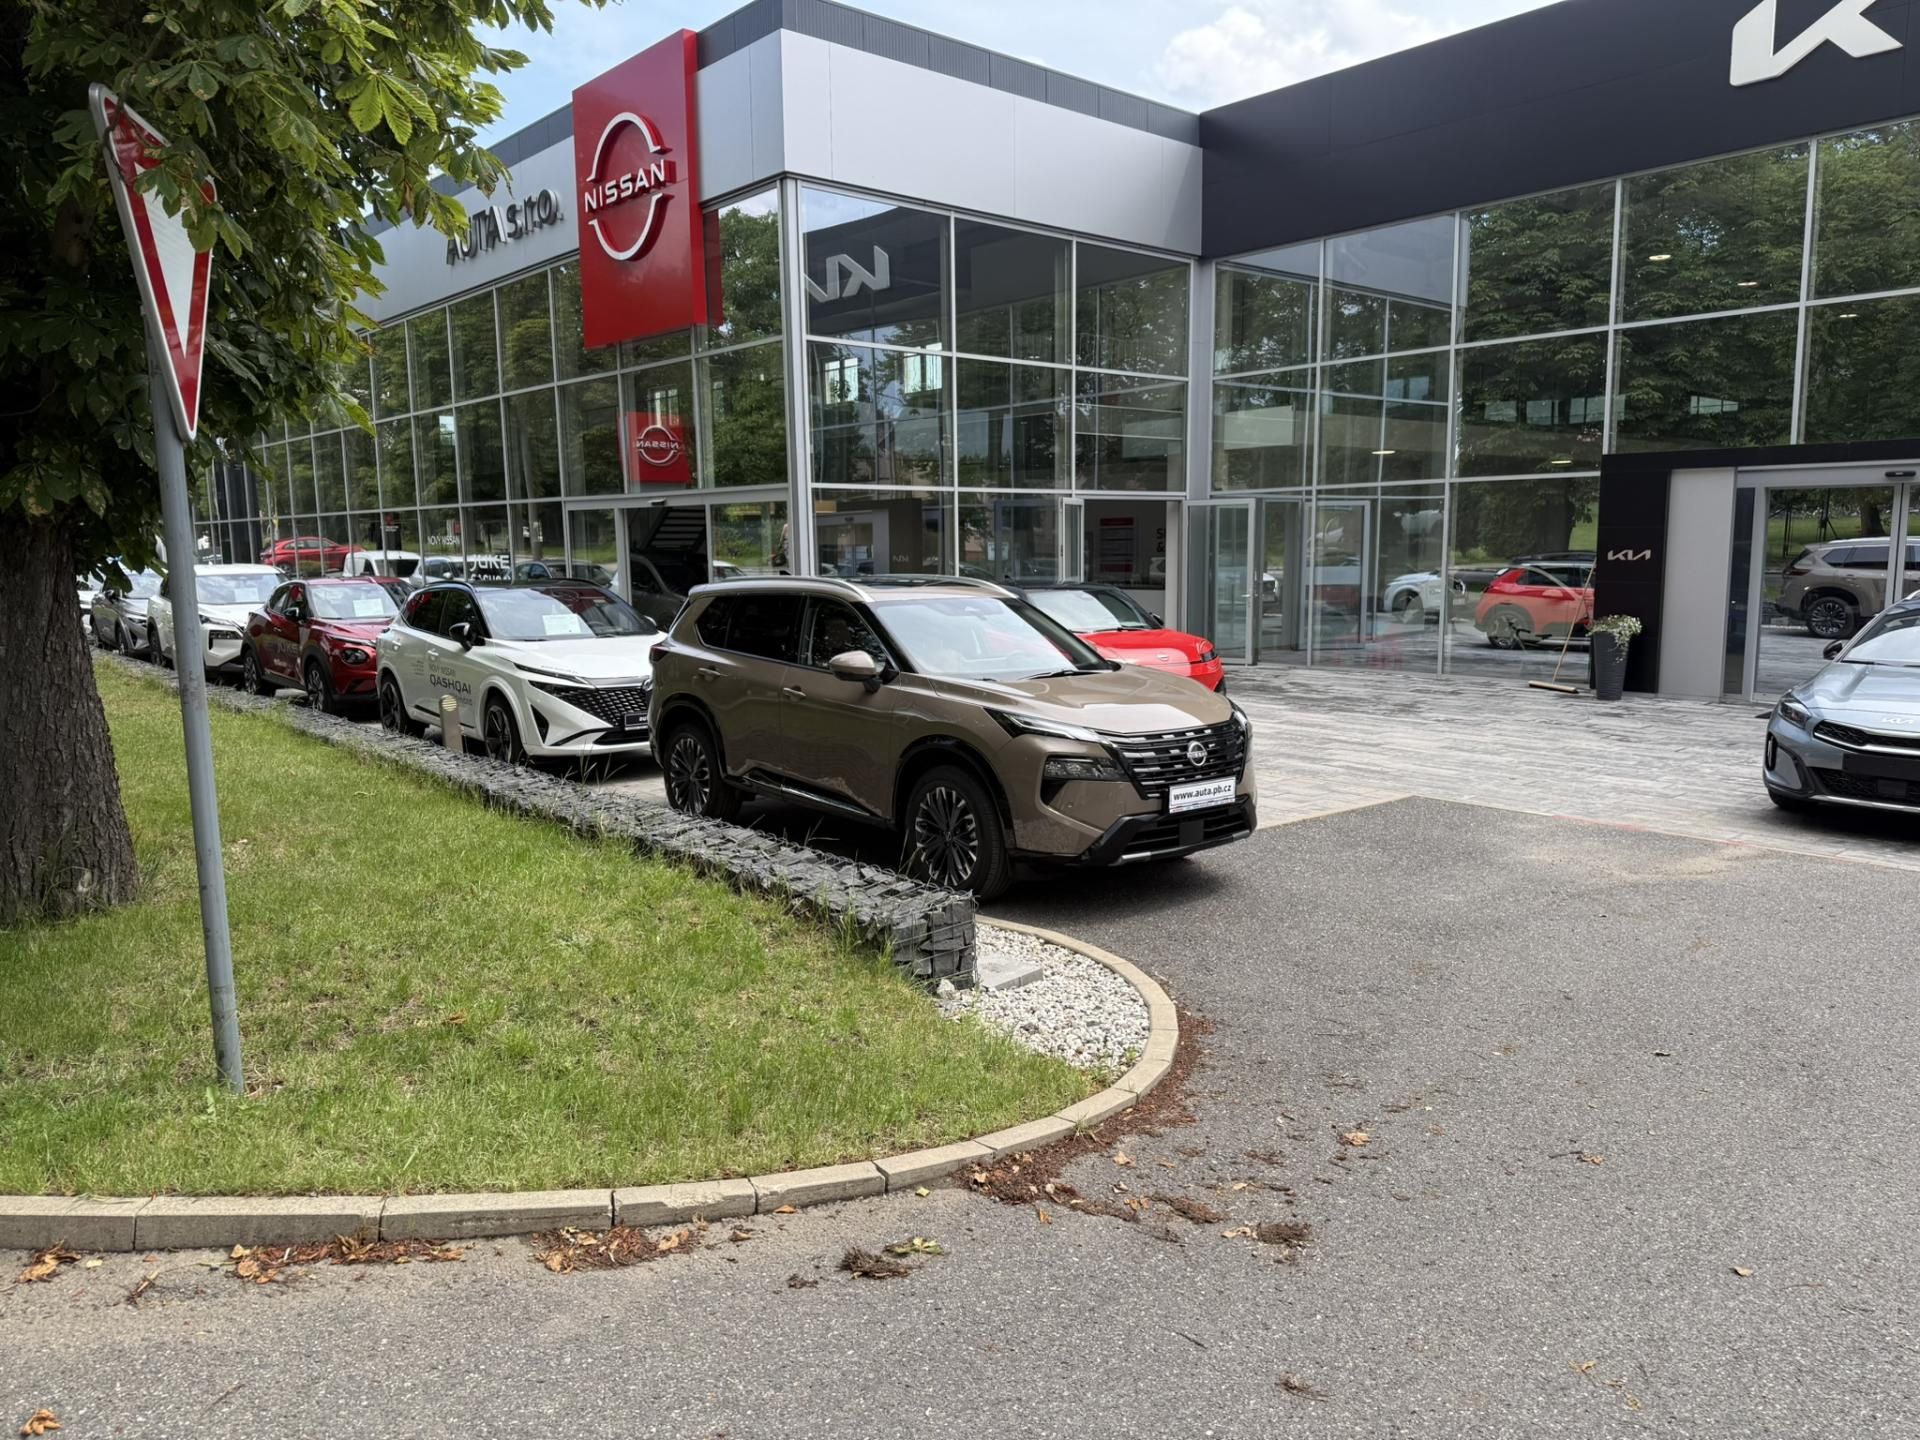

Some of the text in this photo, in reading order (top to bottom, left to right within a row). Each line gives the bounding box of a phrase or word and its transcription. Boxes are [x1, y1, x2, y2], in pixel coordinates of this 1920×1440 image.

[584, 159, 665, 213] NISSAN
[446, 206, 507, 266] AUTA
[442, 535, 460, 545] NISSAN
[470, 554, 511, 572] JUKE
[1607, 549, 1652, 561] KIA
[430, 674, 471, 694] QASHQAI
[1173, 783, 1232, 801] www.auta.pb.cz
